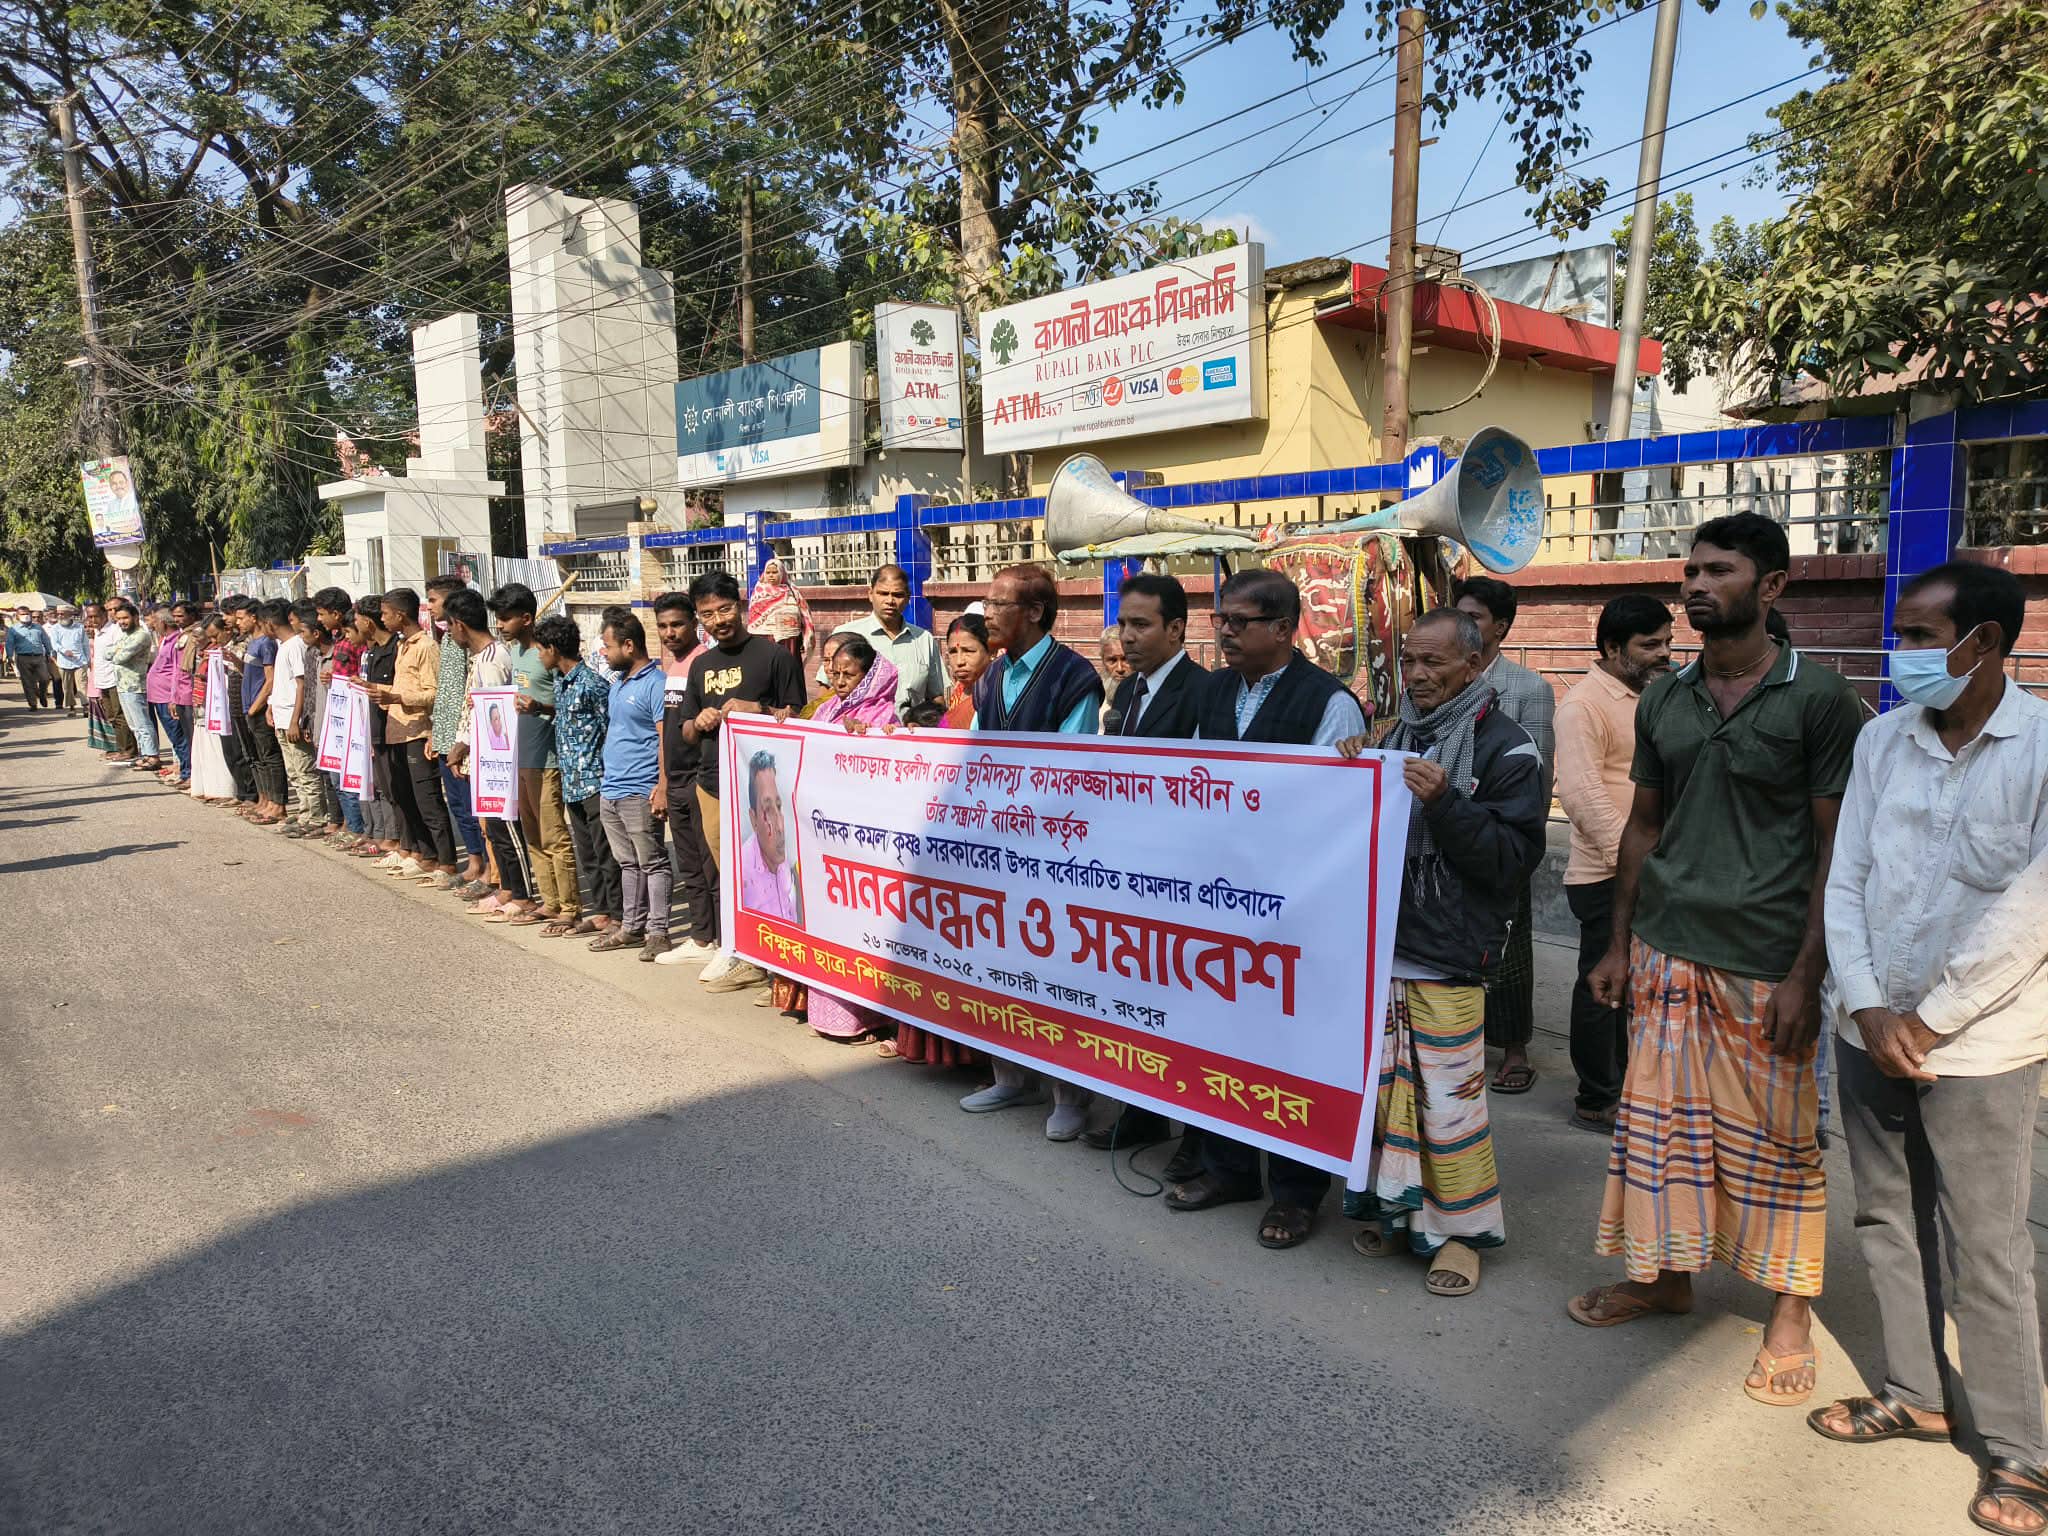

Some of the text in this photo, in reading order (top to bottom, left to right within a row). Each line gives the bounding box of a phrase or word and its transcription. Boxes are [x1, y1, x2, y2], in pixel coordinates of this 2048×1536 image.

[1034, 262, 1236, 359] রূপালী ব্যাংক পিএলসি
[1036, 341, 1155, 383] RUPALI BANK PLC
[1129, 377, 1159, 395] VISA
[702, 384, 807, 424] সোনালী ব্যাংক পিএলসি
[905, 382, 938, 399] ATM
[993, 391, 1063, 426] ATM 24x7
[751, 449, 770, 464] VISA
[834, 752, 1260, 813] গংগাচড়ায় যুবলীগ নেতা ভূমিদস্যু কামরুজ্জামান স্বাধীন ও
[925, 796, 1090, 852] তাঁর সন্ত্রাসী বাহিনী কর্তৃক
[811, 809, 1286, 921] শিক্ষক কমল কৃষ্ণ সরকারের উপর বর্বোরচিত হামলার প্রতিবাদে
[823, 854, 1302, 1017] মানববন্ধন ও সমাবেশ
[863, 932, 882, 949] ২৬
[884, 938, 929, 964] নভেম্বর
[986, 966, 1040, 996] কাচারী
[1112, 998, 1168, 1030] রংপুর
[756, 923, 808, 965] বিক্ষুব্ধ
[812, 944, 925, 1002] ছাত্র-শিক্ষক
[930, 988, 951, 1012] ও
[957, 995, 1067, 1046] নাগরিক
[1200, 1065, 1316, 1129] রংপুর
